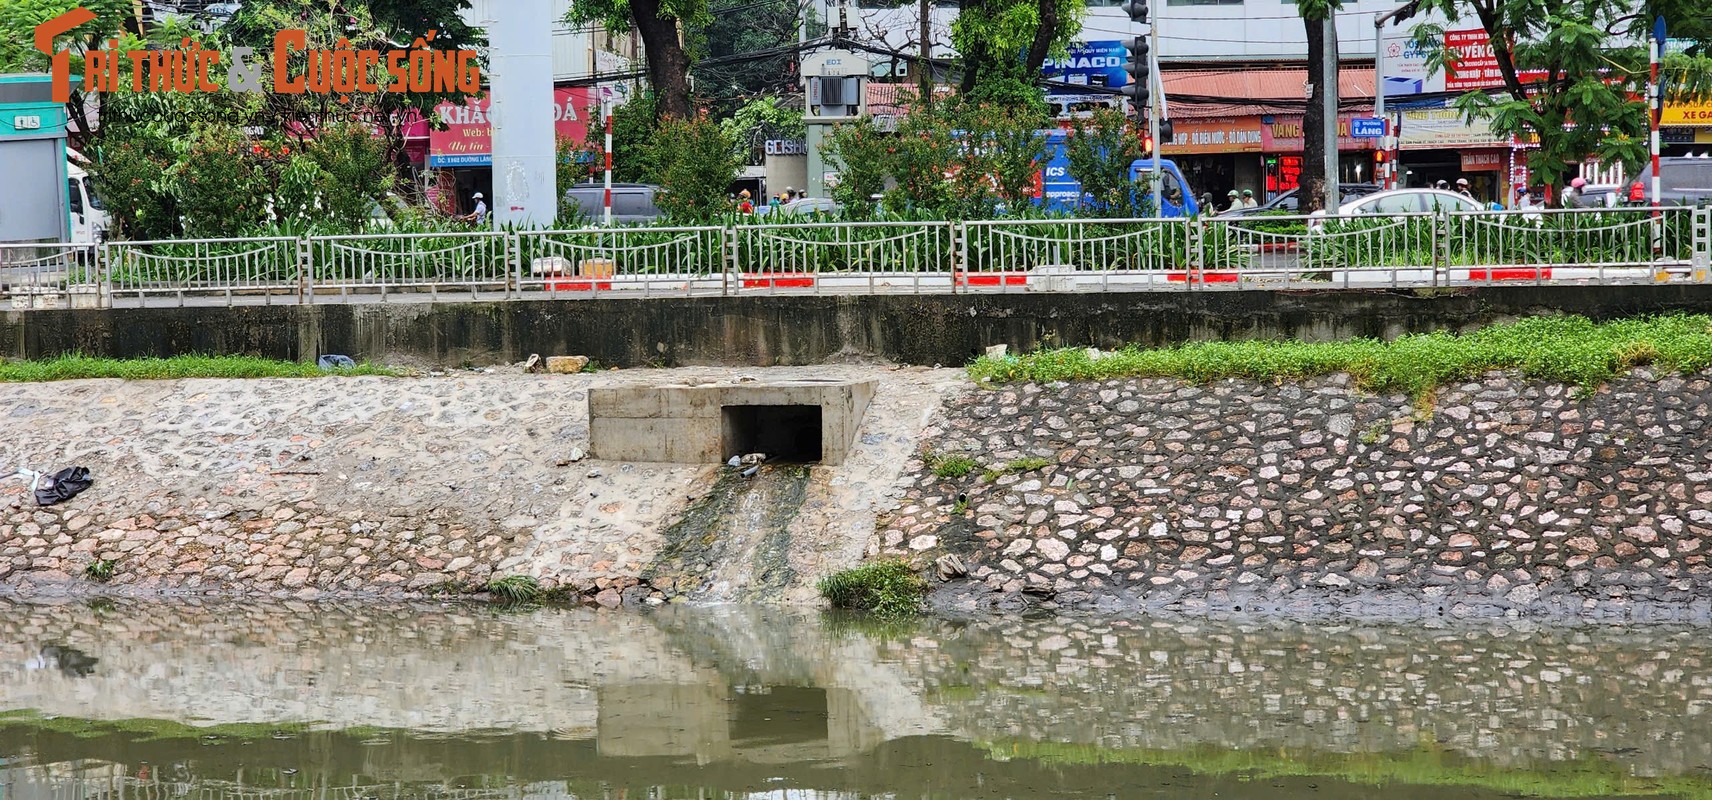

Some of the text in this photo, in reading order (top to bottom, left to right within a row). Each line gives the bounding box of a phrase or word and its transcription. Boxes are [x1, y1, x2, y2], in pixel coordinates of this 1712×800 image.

[1042, 56, 1120, 69] PINACO
[1683, 111, 1696, 119] XE
[462, 128, 484, 137] Web:
[1272, 121, 1299, 138] VÀNG
[1355, 127, 1382, 135] LÁNG
